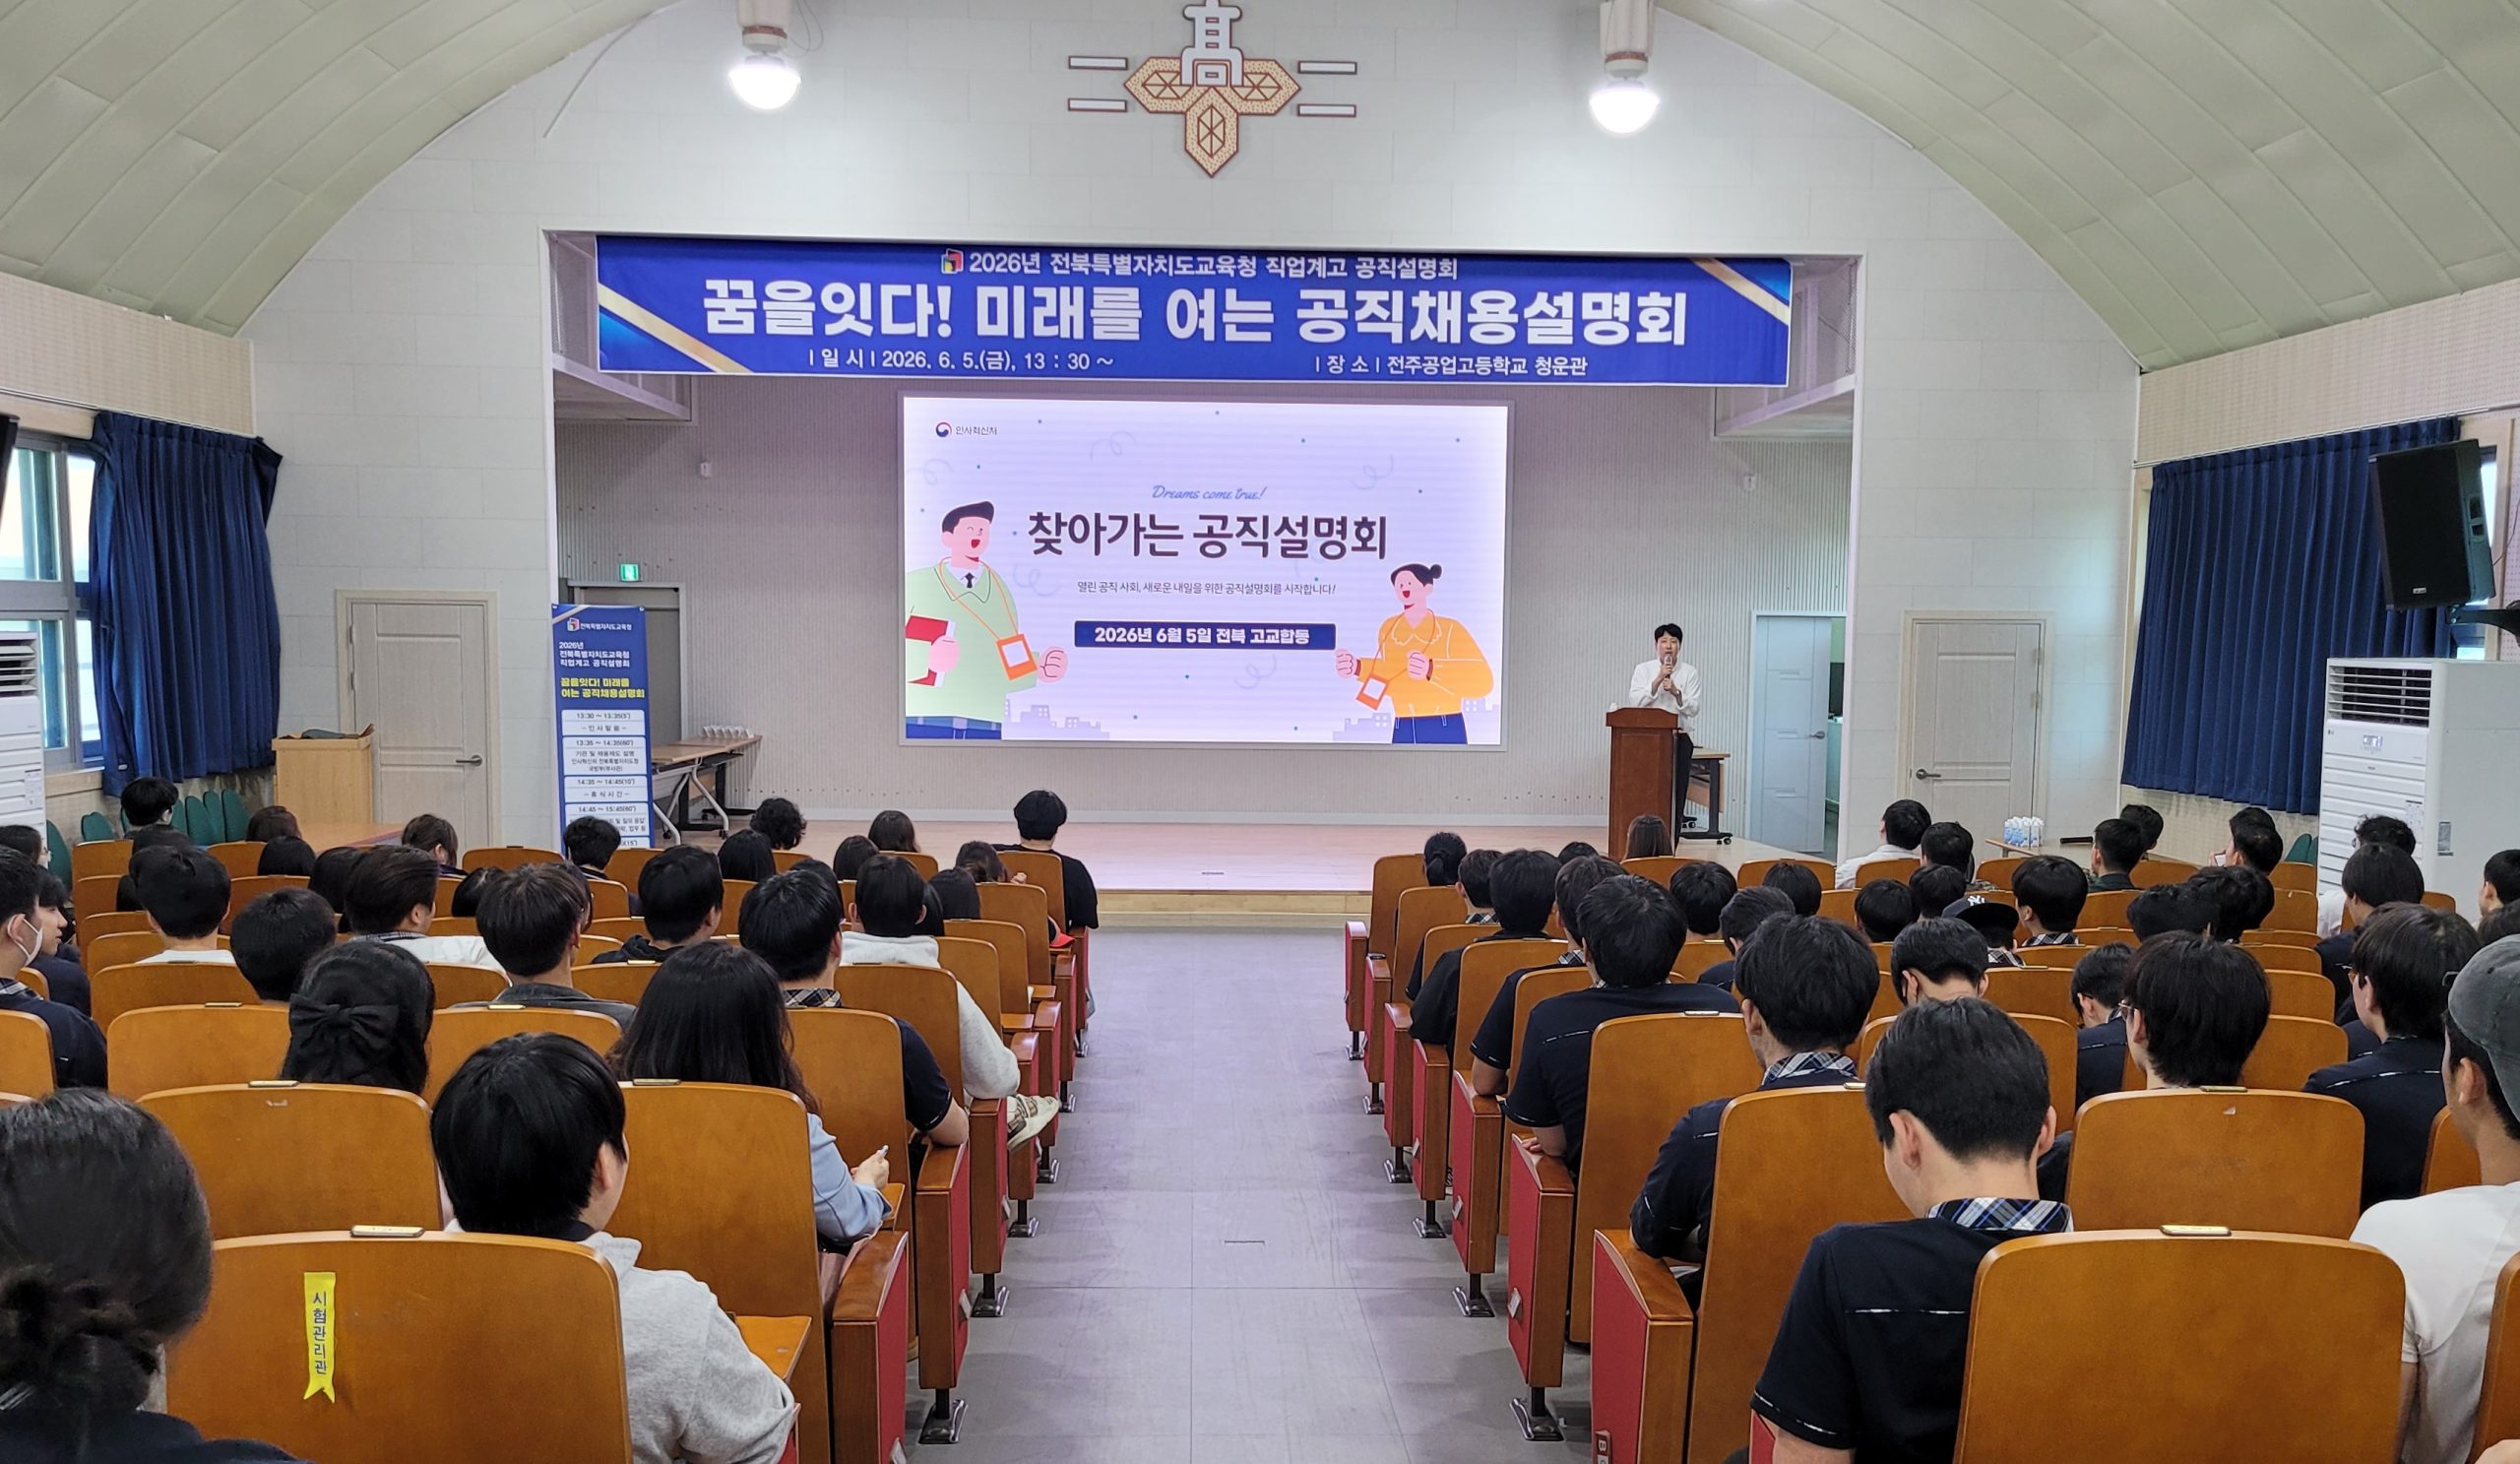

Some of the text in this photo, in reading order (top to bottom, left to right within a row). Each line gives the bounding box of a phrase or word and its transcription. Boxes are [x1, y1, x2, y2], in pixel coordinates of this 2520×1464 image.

[969, 252, 1458, 281] 2026년 전북특별자치도교육청 직업계고 공직설명회
[703, 279, 1686, 345] 꿈을잇다! 미래를 여는 공직채용설명회
[882, 350, 932, 369] 2026.
[938, 350, 956, 369] 6.
[1387, 354, 1529, 376] 전주공업고등학교
[1535, 355, 1589, 376] 청운관
[955, 425, 997, 436] 인사혁신처
[1152, 484, 1268, 500] Dreams come true!
[1028, 511, 1387, 560] 찾아가는 공직설명회
[1077, 581, 1337, 596] 열린 공직 사회, 새로운 내일을 위한 공직설명회를 시작합니다!
[1095, 626, 1310, 645] 2026년 6월 5일 전북 고교합동
[558, 641, 584, 650] 2026년
[559, 650, 630, 660] 전북특별자치도교육청
[560, 659, 591, 668] 직업계고
[601, 677, 630, 688] 미래를
[561, 688, 645, 699] 여는 공직채용설명회
[312, 1291, 327, 1375] 시험관리관
